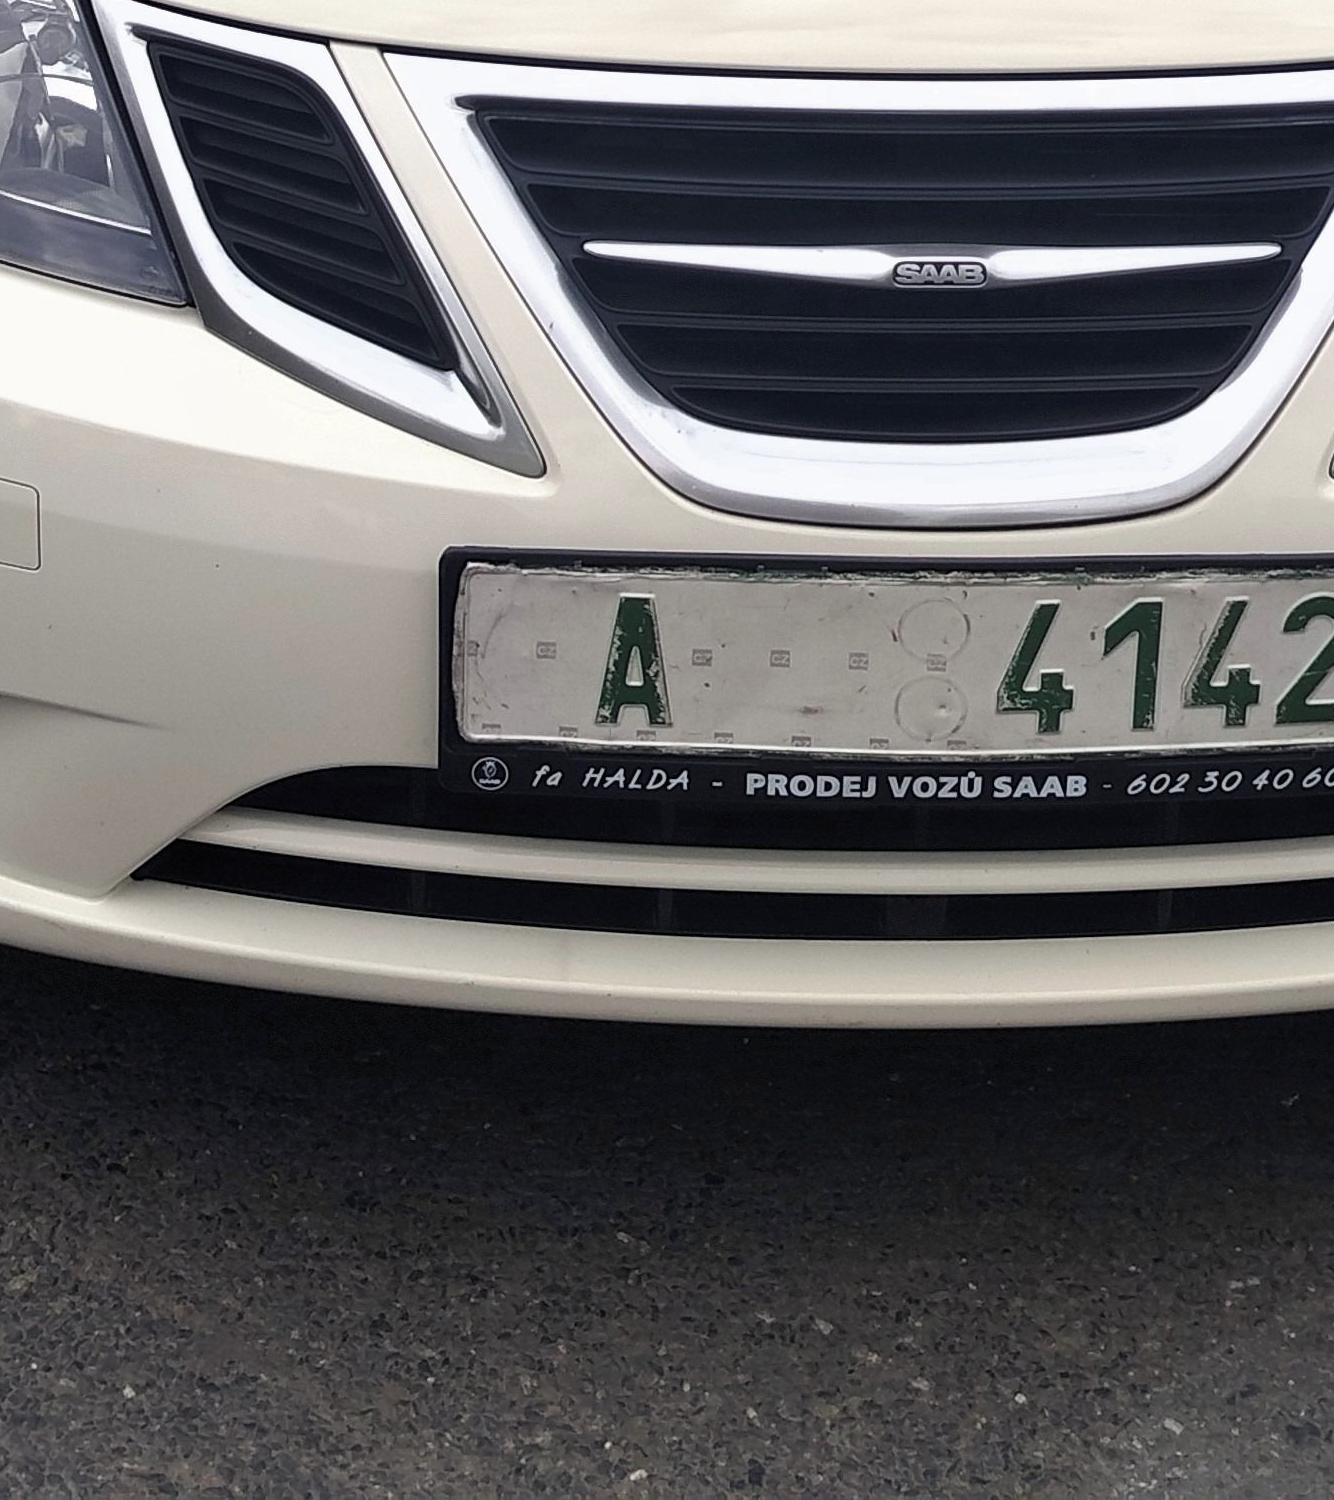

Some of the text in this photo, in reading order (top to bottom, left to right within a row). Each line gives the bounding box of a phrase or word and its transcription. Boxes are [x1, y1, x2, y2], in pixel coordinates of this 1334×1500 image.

[895, 263, 985, 284] SAAB
[595, 593, 673, 727] A
[531, 765, 563, 788] fa
[581, 767, 689, 791] HALDA
[746, 772, 877, 798] PRODEJ
[888, 770, 983, 799] VOZŮ
[993, 775, 1088, 798] SAAB
[1127, 773, 1190, 795] 602
[1197, 770, 1243, 794] 30
[1252, 768, 1294, 791] 40
